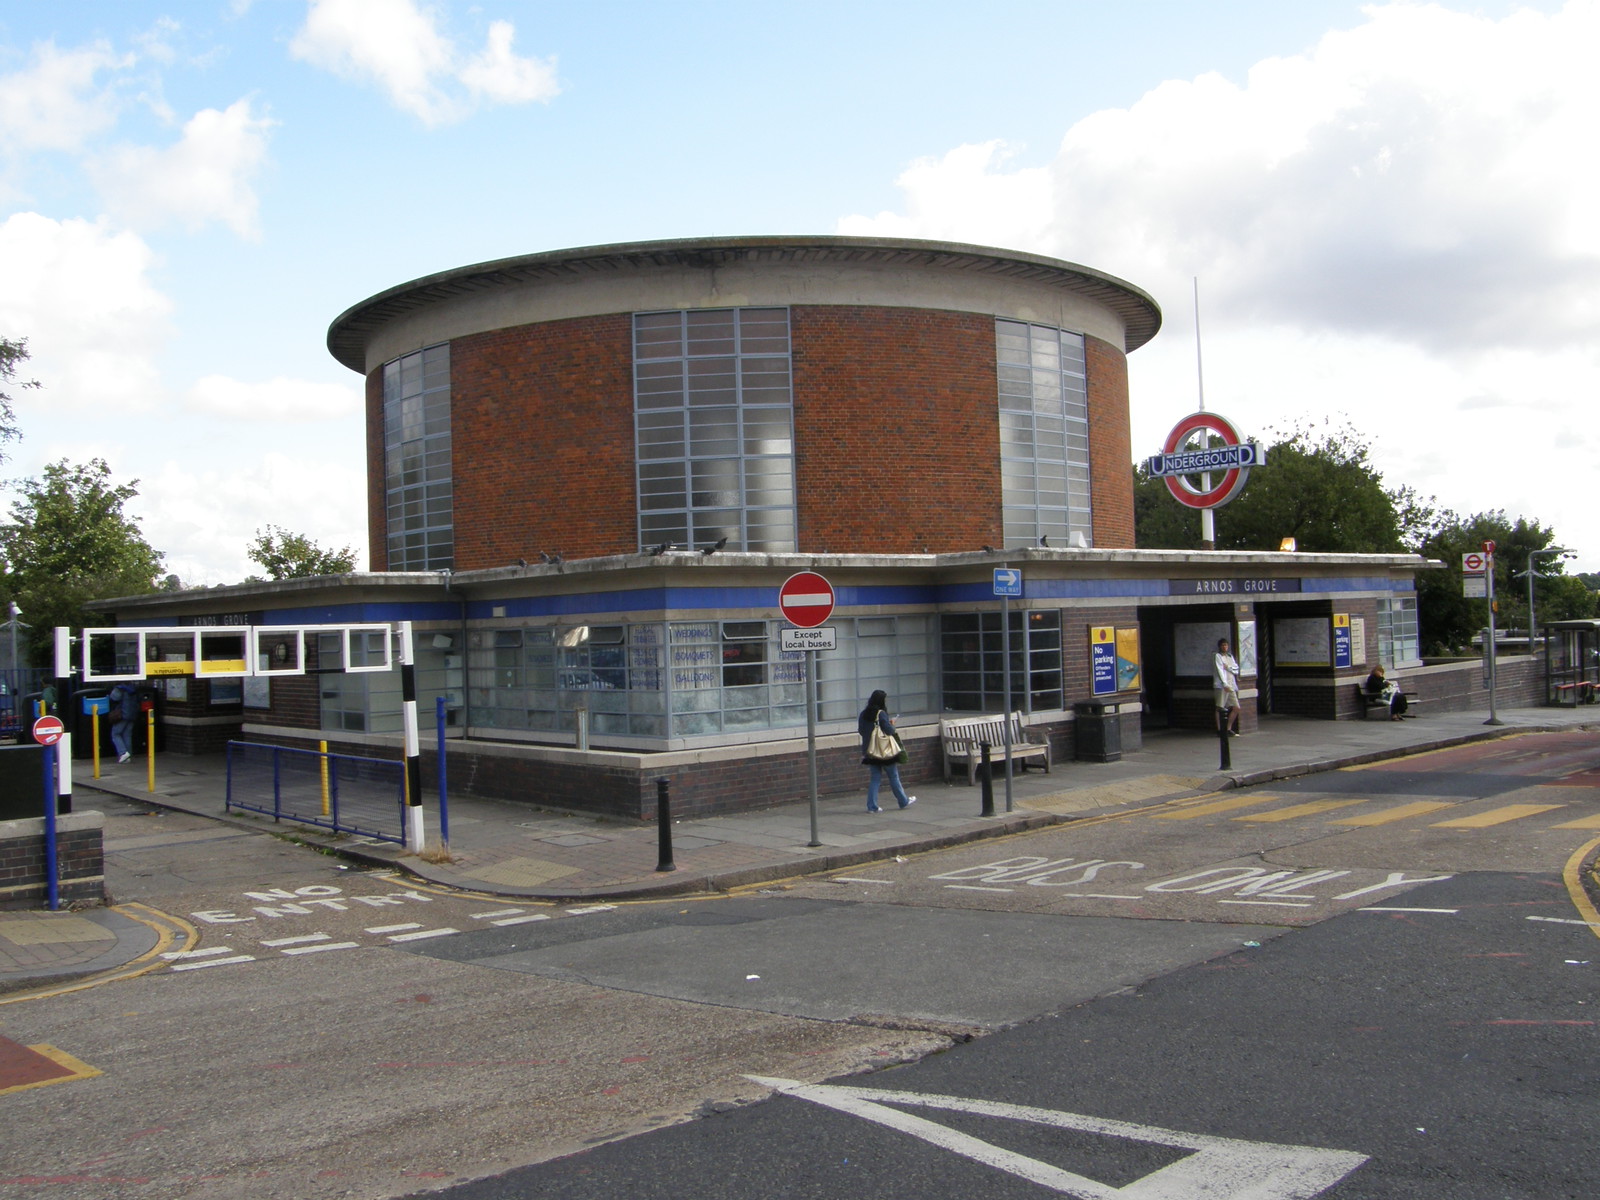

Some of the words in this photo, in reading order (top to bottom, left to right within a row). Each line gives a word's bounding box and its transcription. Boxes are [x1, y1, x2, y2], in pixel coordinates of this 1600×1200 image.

[1151, 445, 1254, 475] UNDERGROUND
[1484, 541, 1492, 551] T
[1196, 580, 1233, 592] ARNOS
[1244, 580, 1277, 591] GROVE
[193, 616, 217, 626] ARNOS
[223, 614, 249, 626] GROVE
[675, 628, 713, 638] WEDDINGS
[794, 631, 822, 639] Except
[785, 640, 805, 649] local
[808, 640, 832, 648] buses
[1094, 646, 1103, 654] No
[675, 650, 714, 661] BOUQUETS
[1095, 655, 1114, 665] parking
[675, 672, 715, 683] BALLOONS
[927, 856, 1145, 887] BUS
[1144, 866, 1453, 900] ONLY
[243, 885, 342, 902] NO
[190, 890, 433, 924] ENTRY
